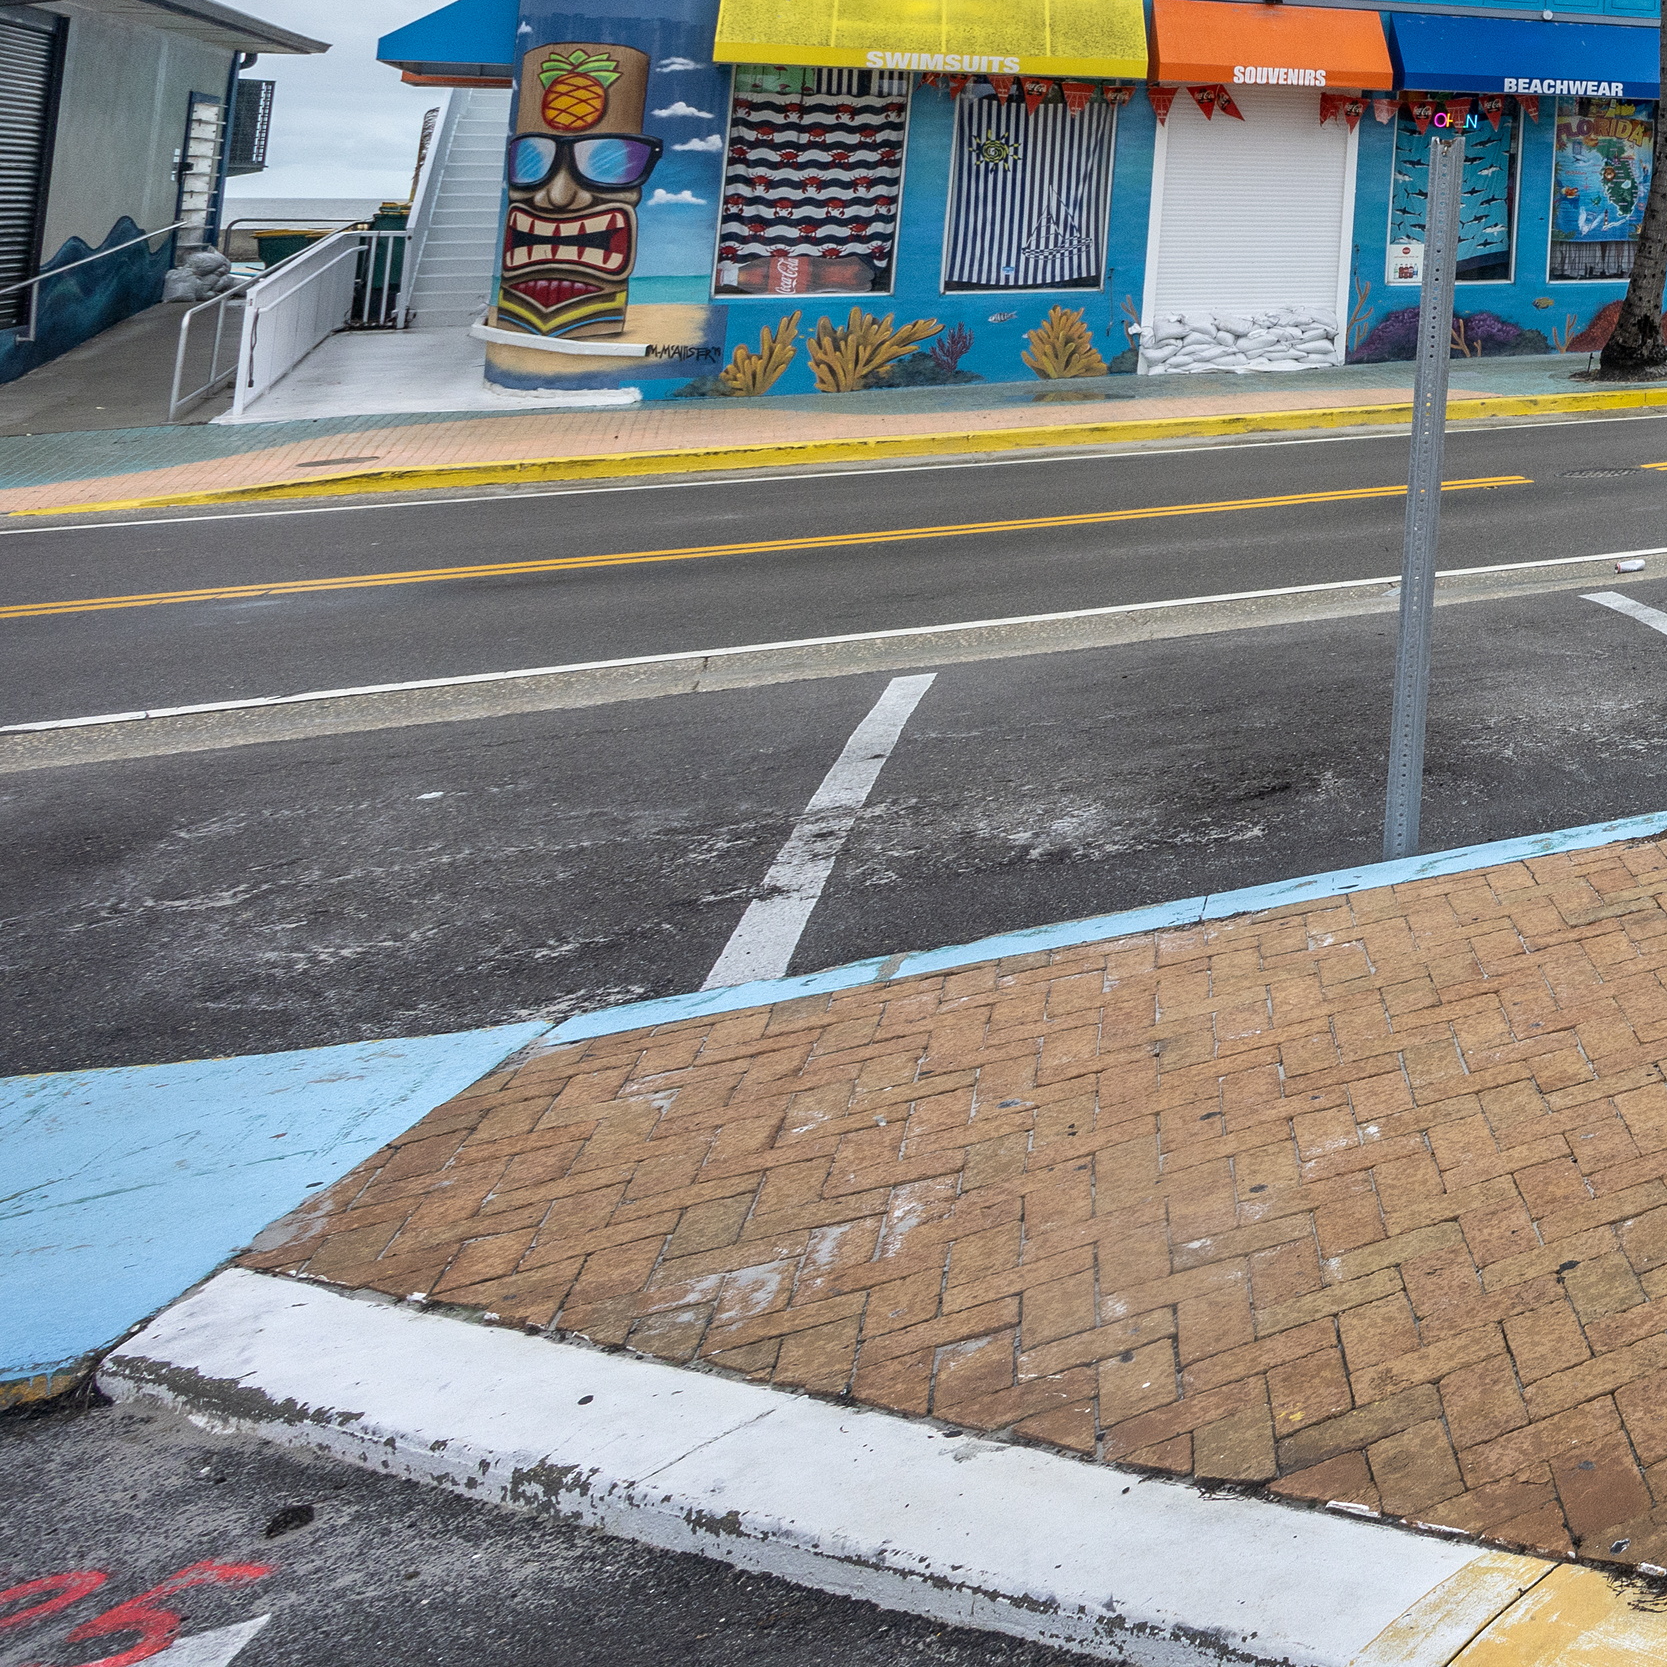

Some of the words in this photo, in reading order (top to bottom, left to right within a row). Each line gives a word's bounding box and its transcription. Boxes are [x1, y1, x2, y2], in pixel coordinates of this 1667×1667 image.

[866, 51, 1020, 73] SWIMSUITS
[1233, 66, 1326, 87] SOUVENIRS
[1504, 78, 1624, 96] BEACHWEAR
[1557, 116, 1645, 147] FLORIDA
